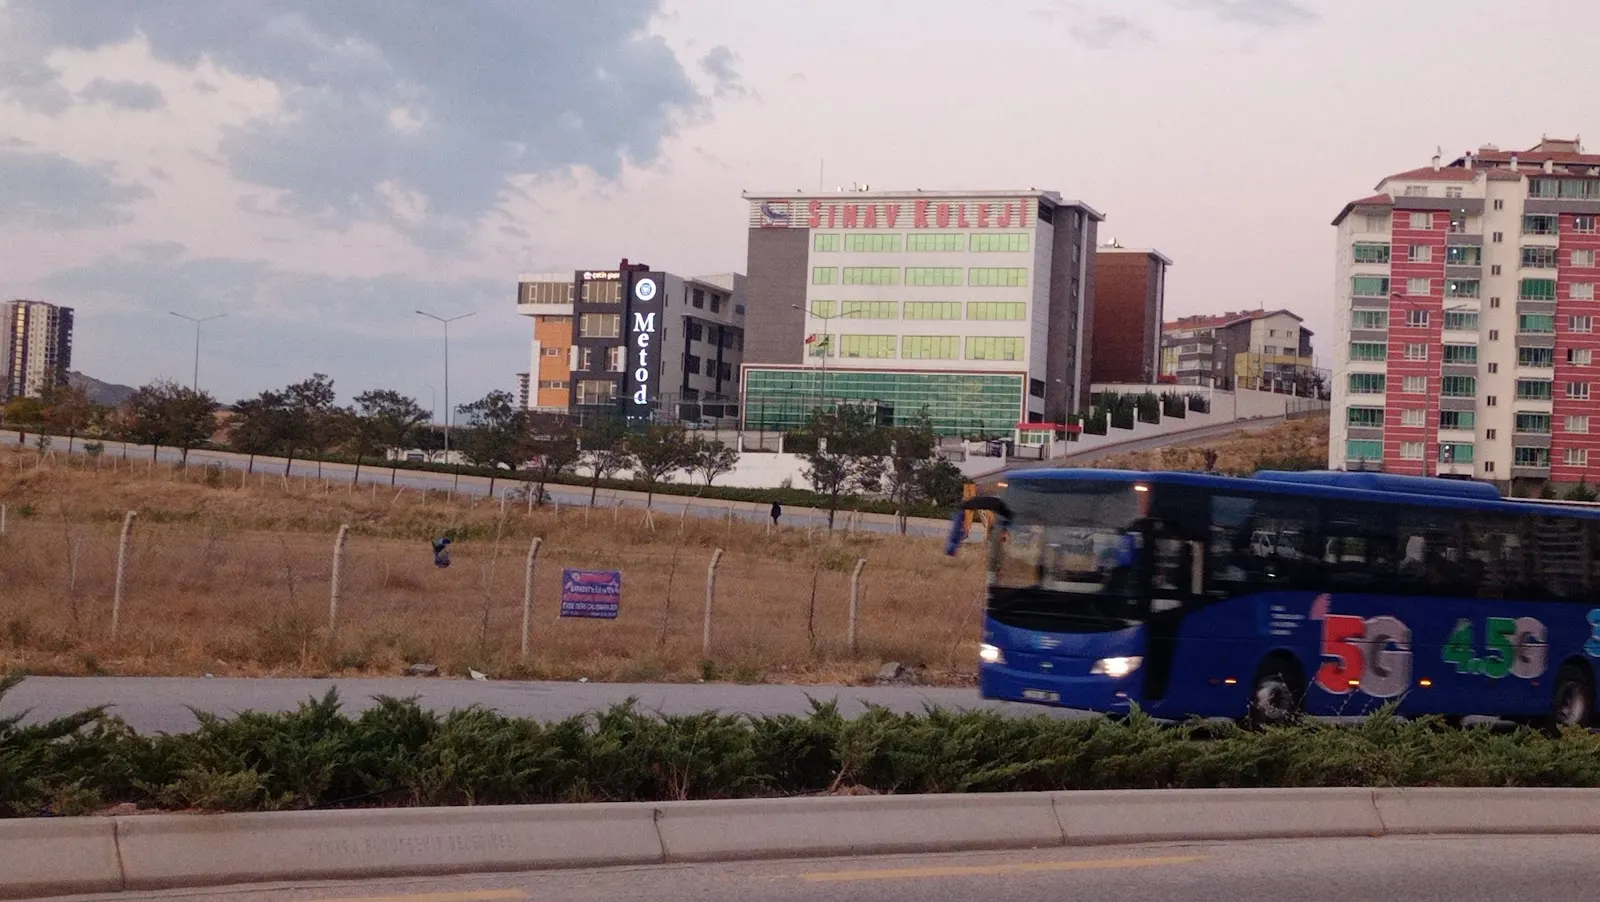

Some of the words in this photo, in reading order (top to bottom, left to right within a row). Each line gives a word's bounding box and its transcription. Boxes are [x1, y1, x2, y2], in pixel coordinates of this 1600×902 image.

[807, 200, 901, 229] SINAV
[632, 312, 656, 405] Metod
[1315, 613, 1413, 698] 5G
[1441, 616, 1549, 679] 4.5G
